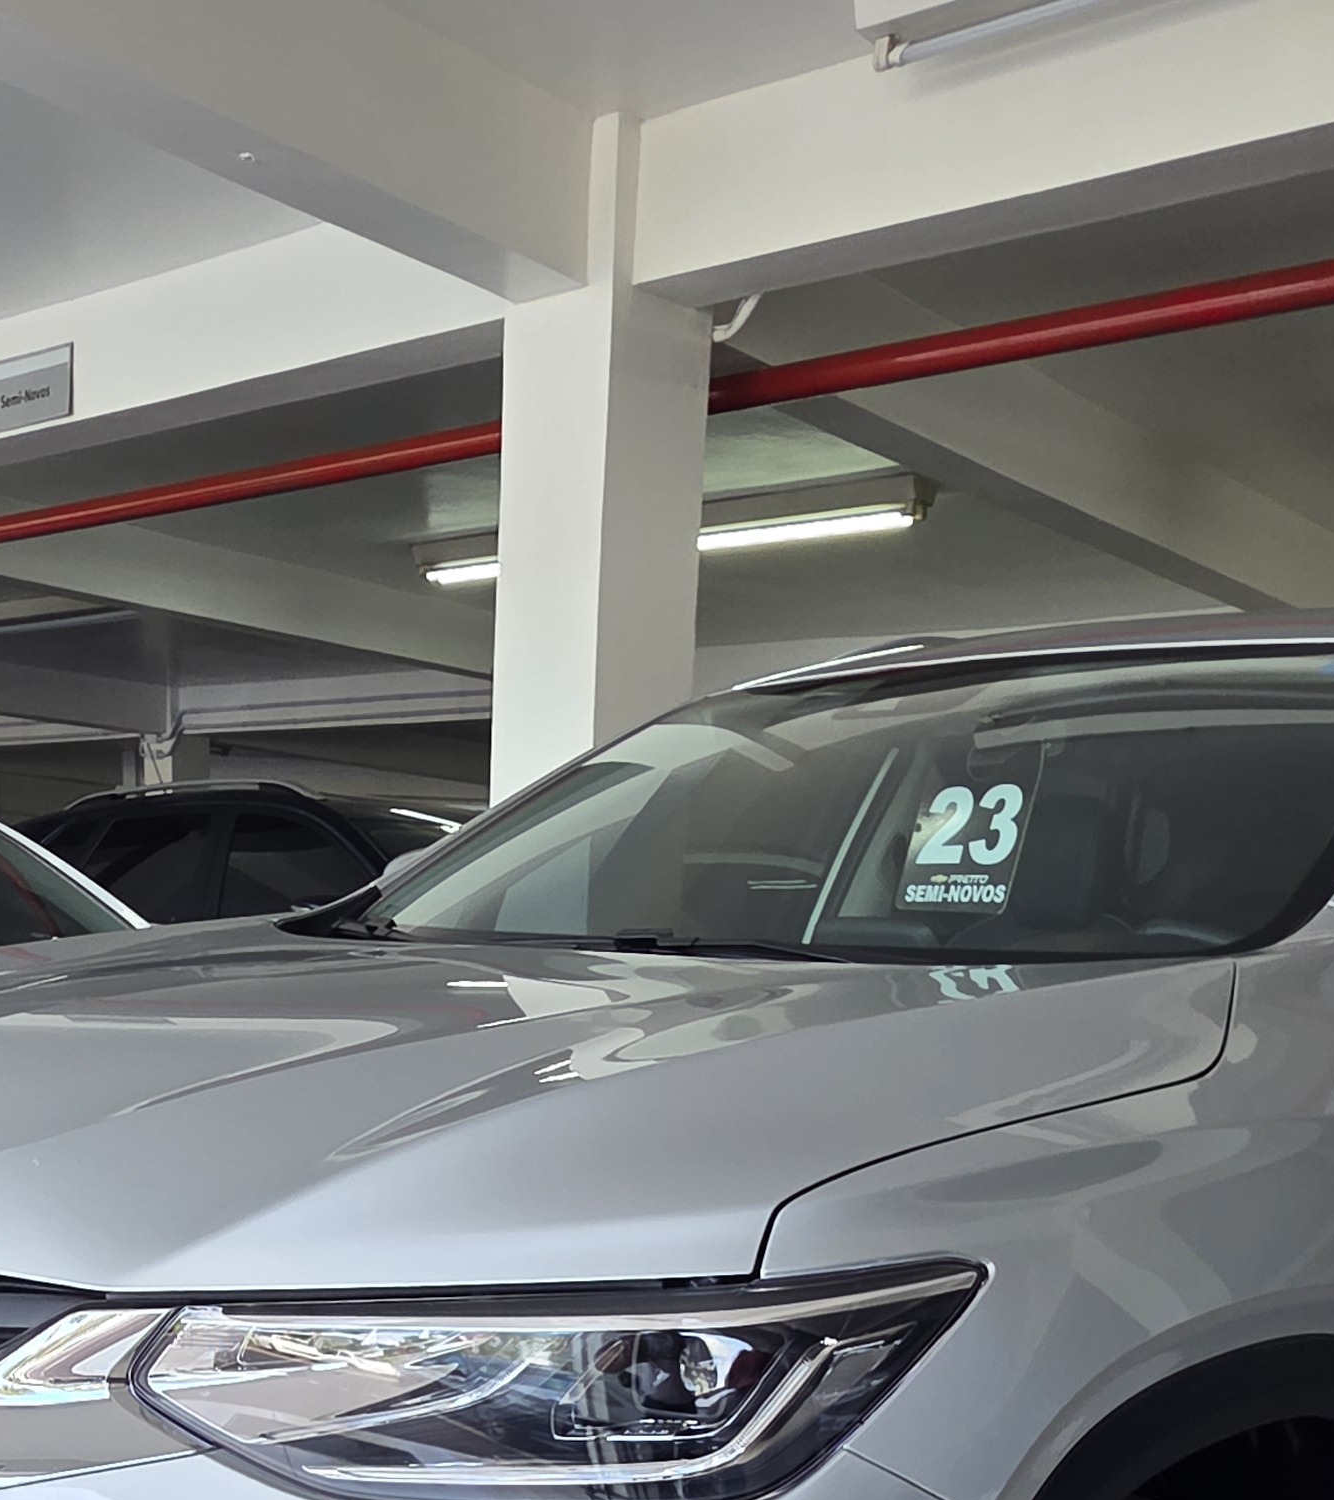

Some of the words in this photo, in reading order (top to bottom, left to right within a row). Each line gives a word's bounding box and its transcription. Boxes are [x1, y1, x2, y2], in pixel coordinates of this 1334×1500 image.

[0, 386, 50, 409] Semi-Novos
[915, 783, 1023, 865] 23
[905, 884, 1006, 903] SEMI-NOVOS
